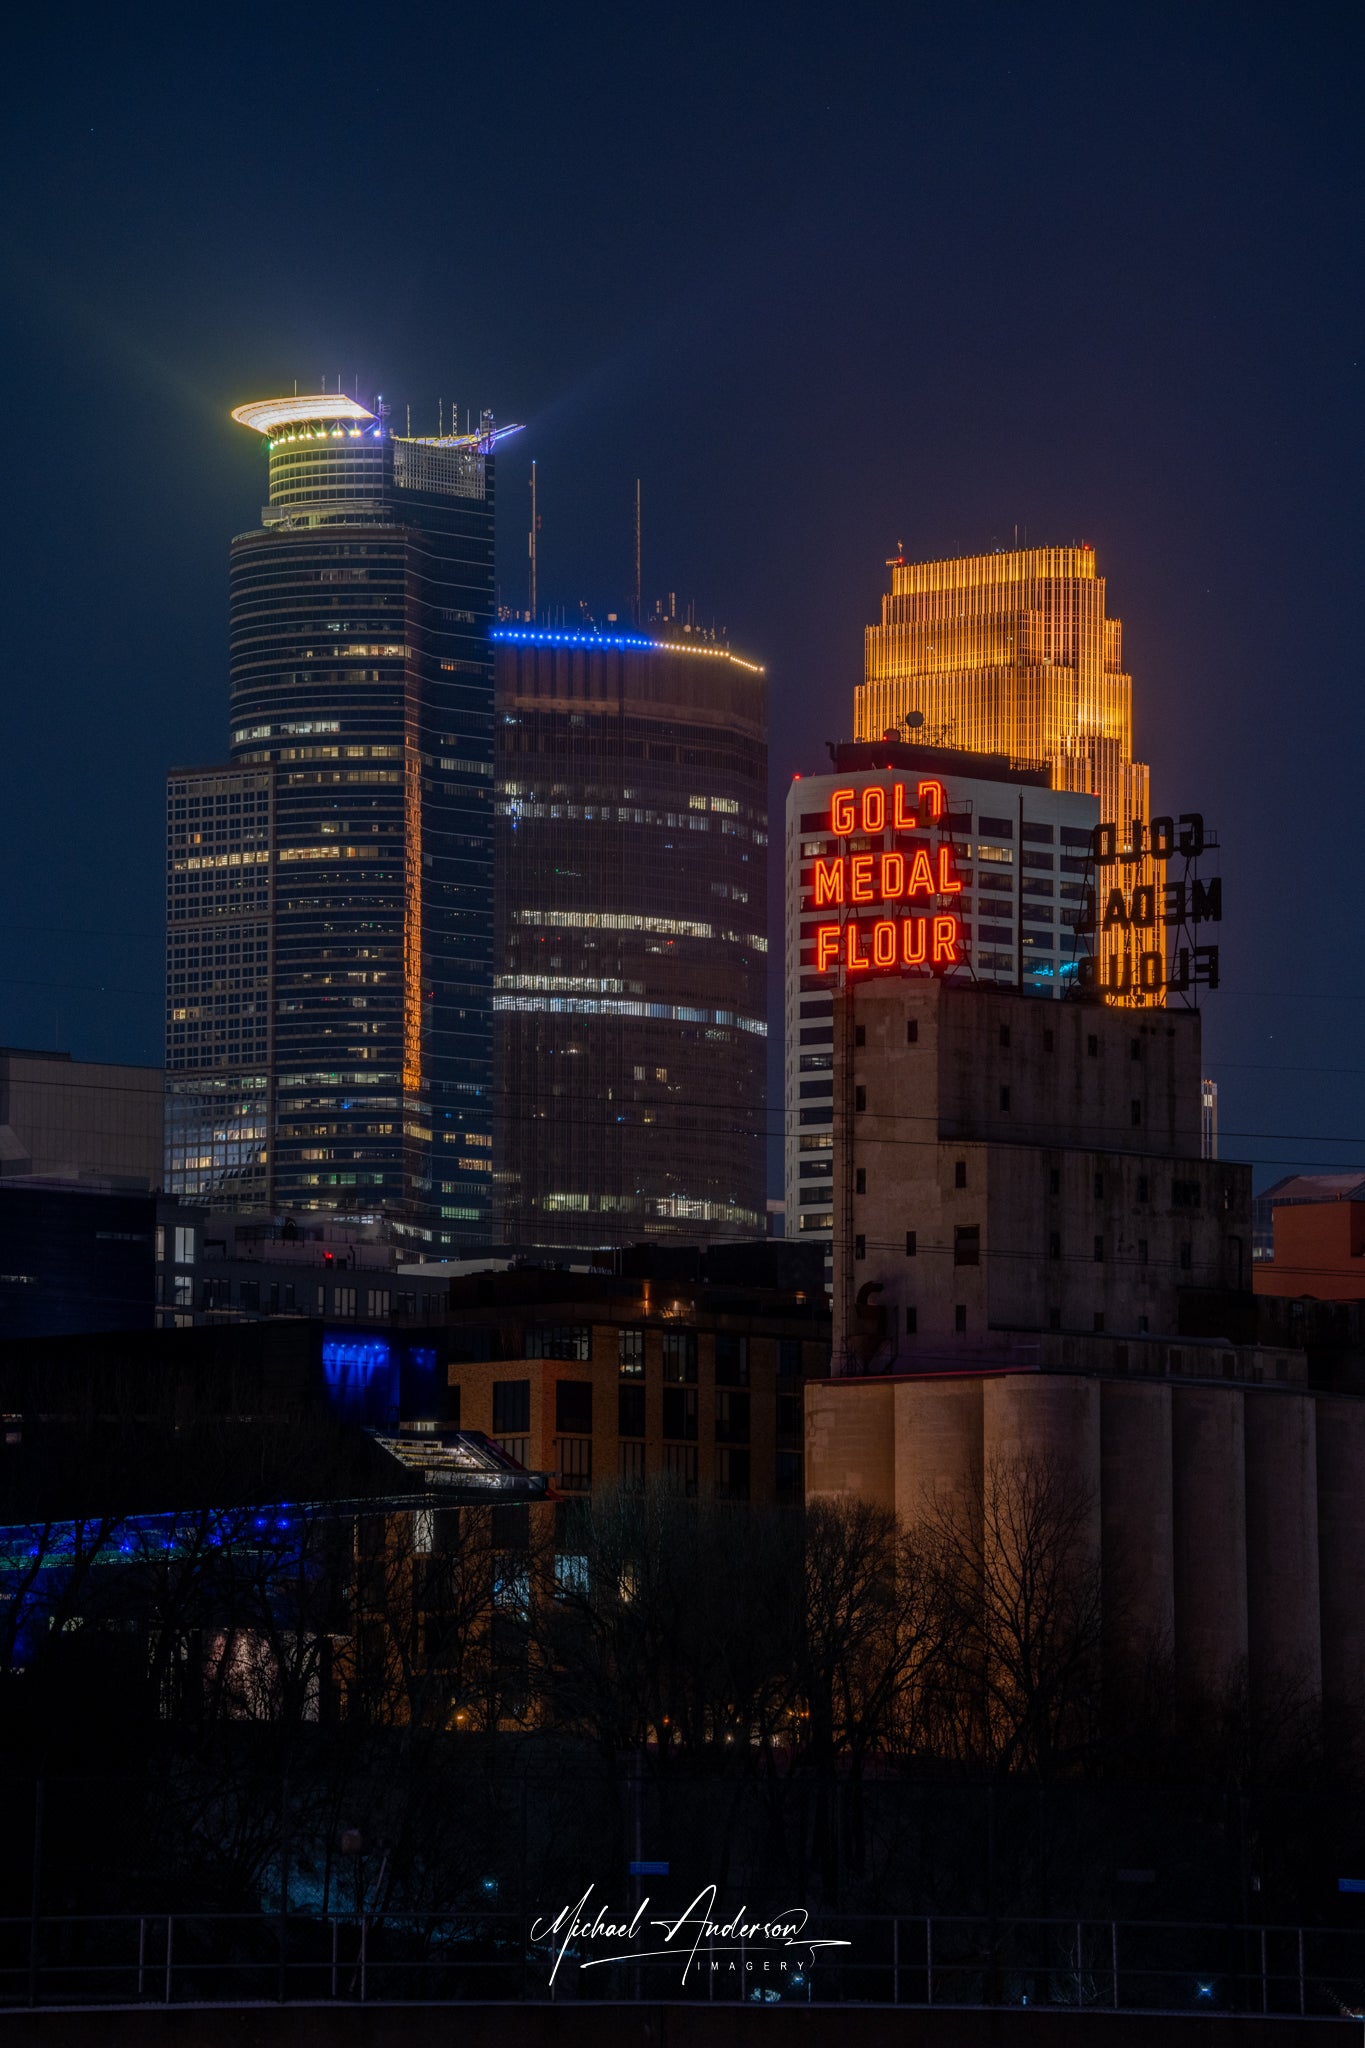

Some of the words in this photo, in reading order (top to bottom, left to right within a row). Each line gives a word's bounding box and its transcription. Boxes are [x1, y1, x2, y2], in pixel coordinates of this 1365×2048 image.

[831, 780, 942, 836] GOLD
[814, 847, 962, 905] MEDAL
[817, 915, 957, 972] FLOUR
